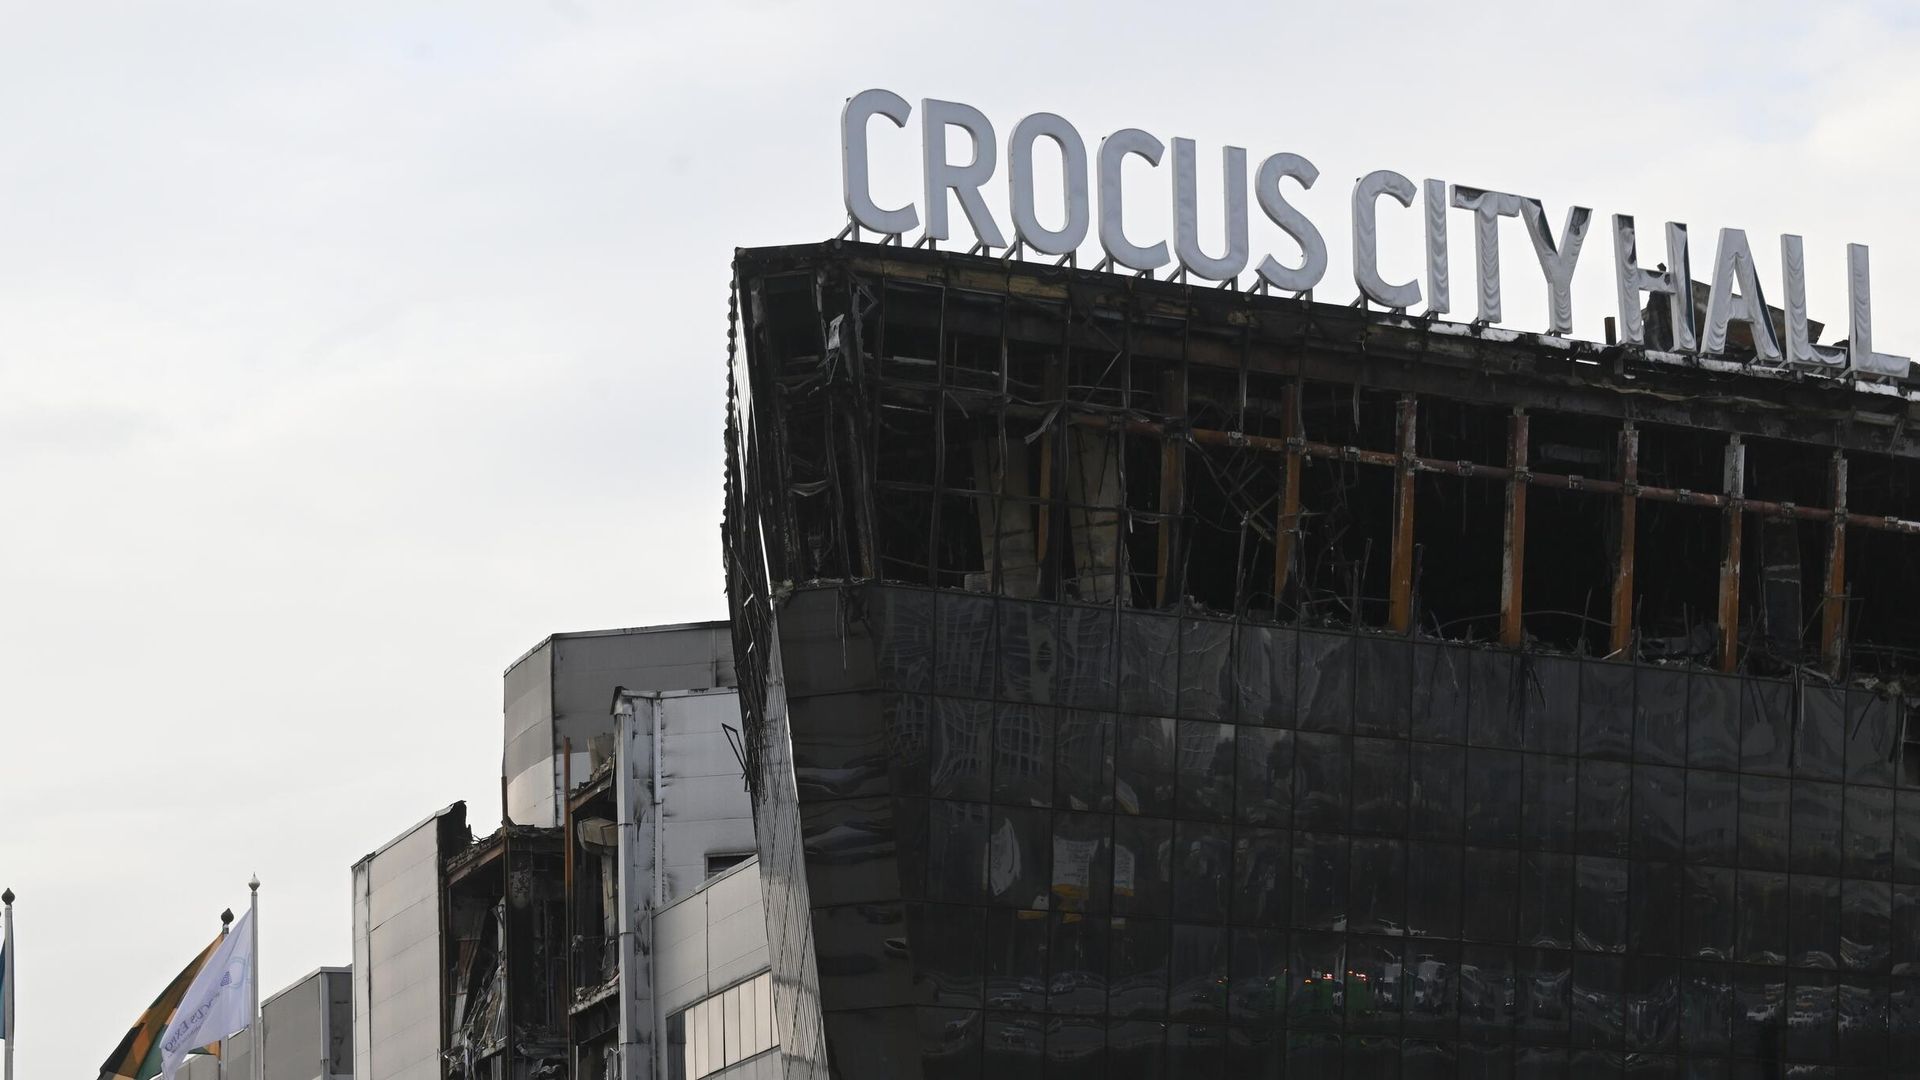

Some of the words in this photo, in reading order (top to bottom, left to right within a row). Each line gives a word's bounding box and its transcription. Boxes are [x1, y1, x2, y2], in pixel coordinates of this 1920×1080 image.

[841, 88, 1328, 291] CROCUS
[1352, 170, 1593, 334] CITY
[1612, 213, 1911, 378] HALL
